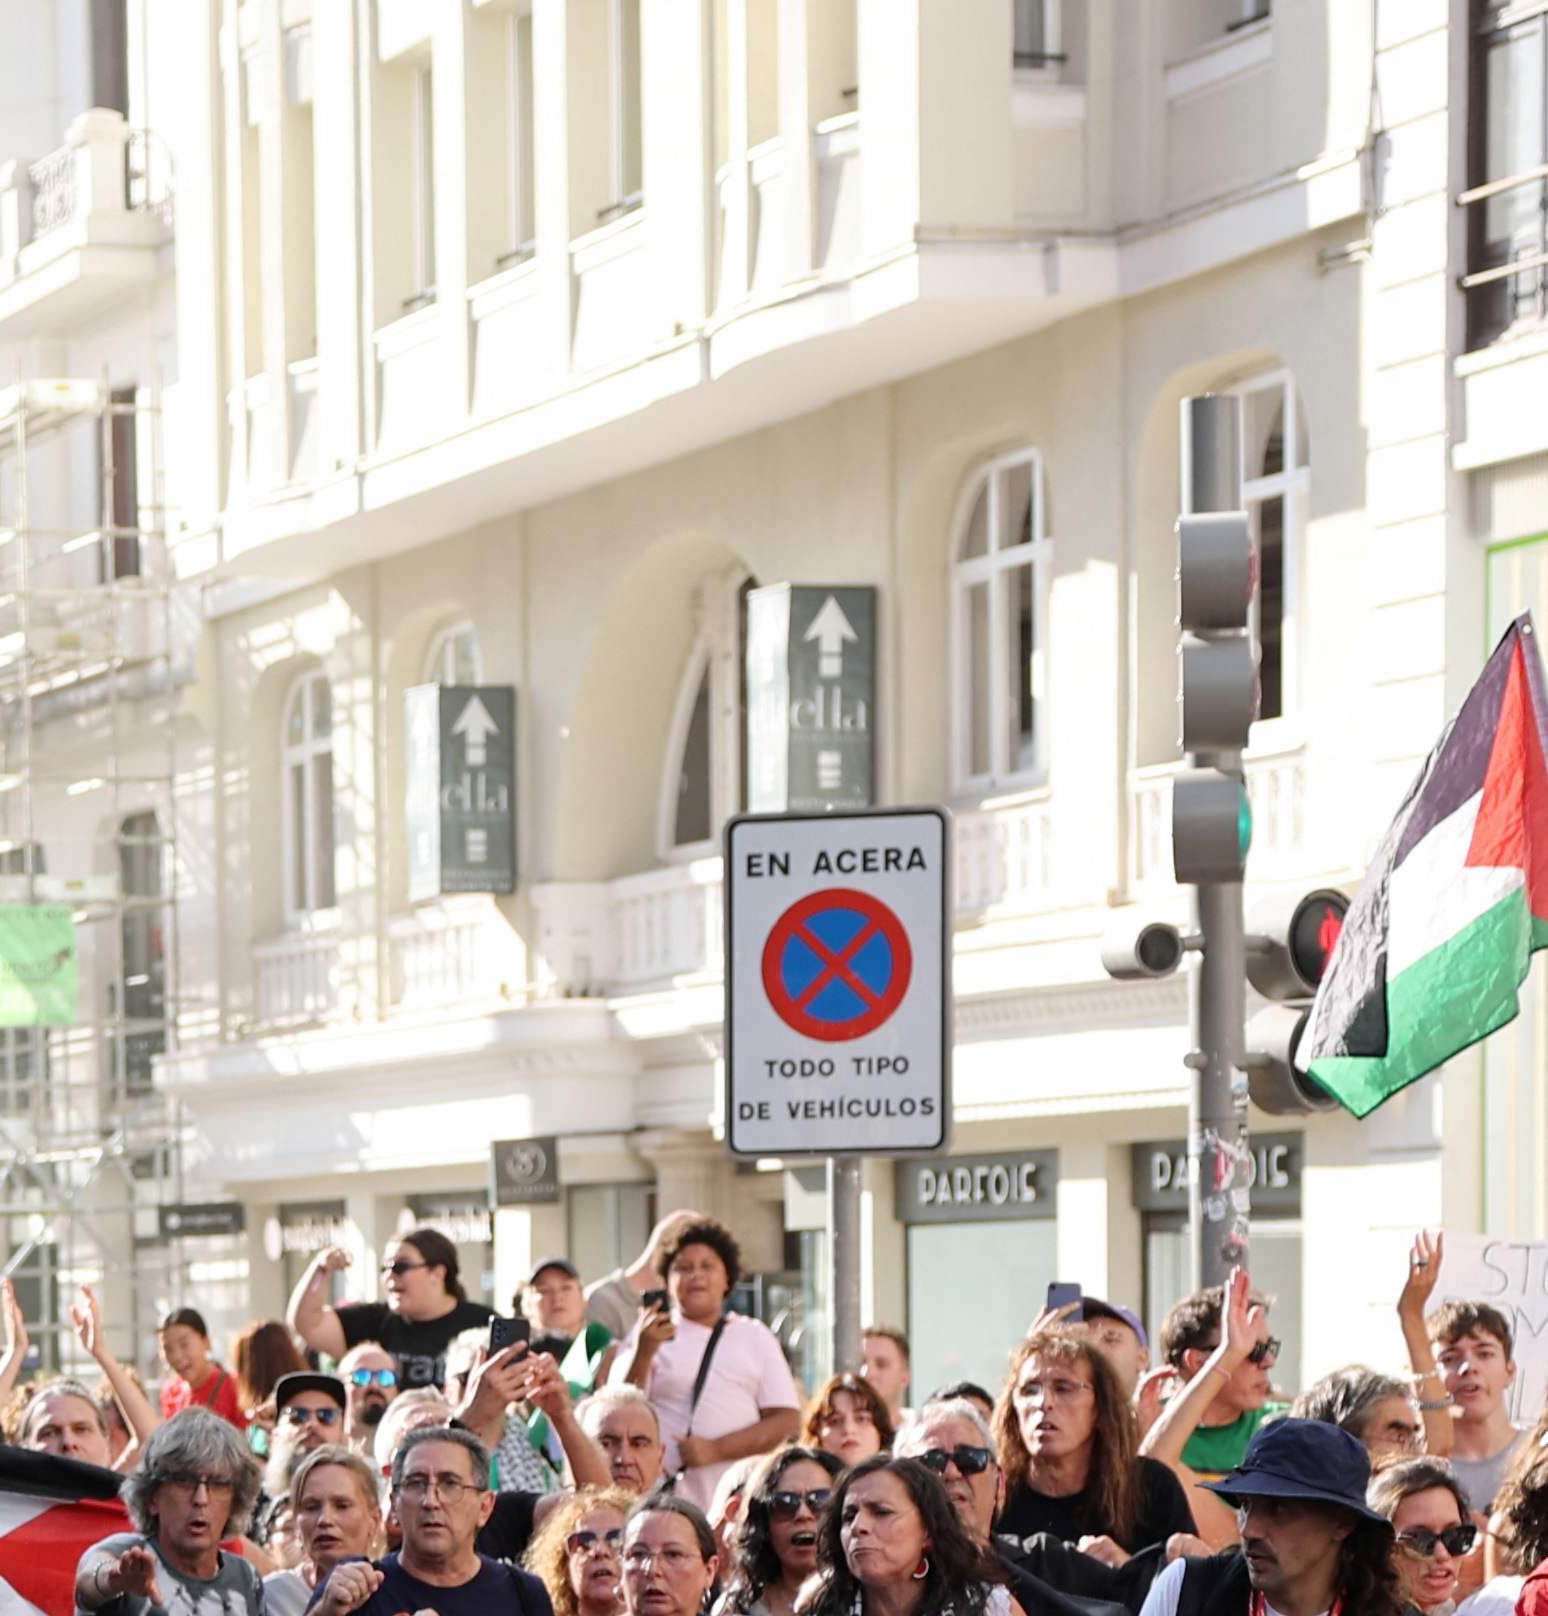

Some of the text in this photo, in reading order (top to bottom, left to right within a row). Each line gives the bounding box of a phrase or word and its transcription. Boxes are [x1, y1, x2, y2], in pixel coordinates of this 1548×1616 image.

[746, 848, 927, 878] EN ACERA
[765, 1056, 909, 1078] TODO TIPO
[739, 1096, 935, 1121] DE VEHÍCULOS
